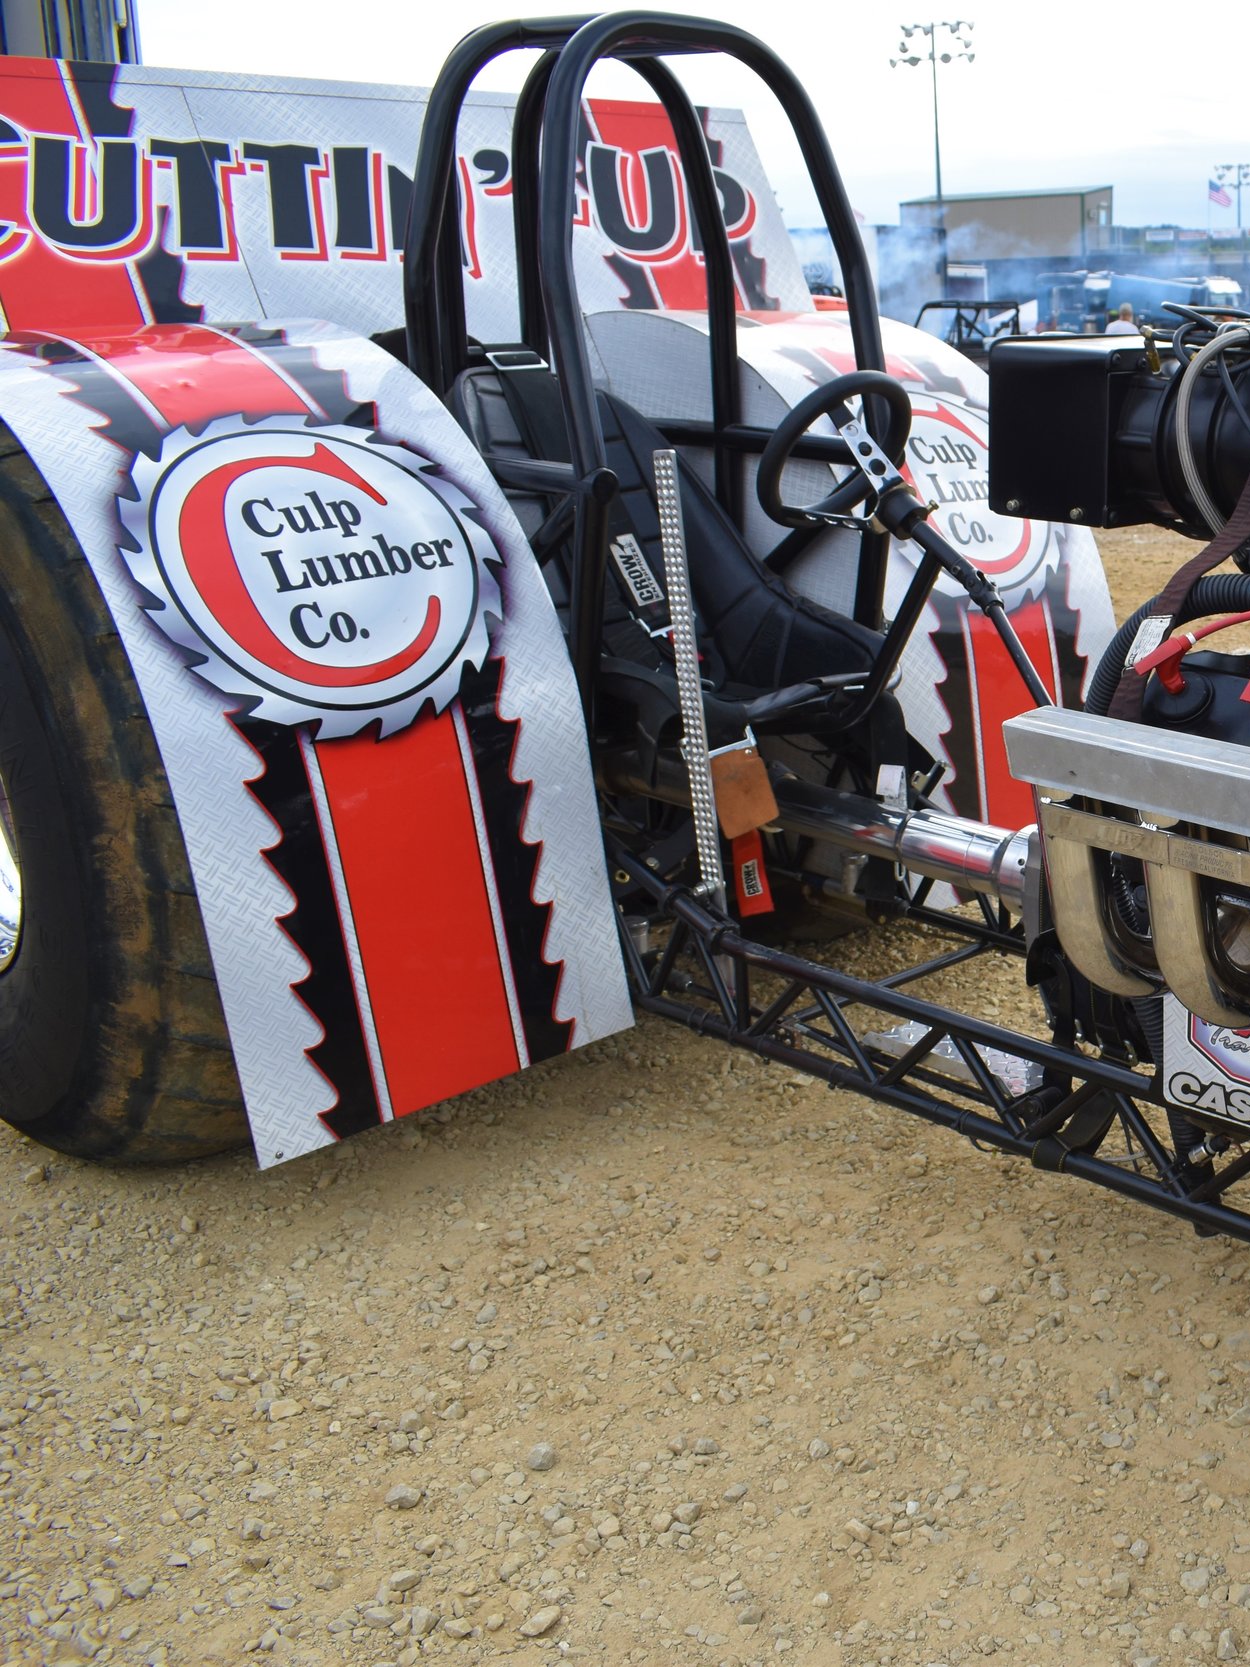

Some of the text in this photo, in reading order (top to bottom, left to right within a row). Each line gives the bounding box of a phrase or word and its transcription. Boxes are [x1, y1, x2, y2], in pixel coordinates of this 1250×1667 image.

[908, 435, 978, 470] Culp
[925, 470, 989, 504] Lum
[240, 490, 362, 539] Culp
[947, 511, 994, 546] Co.
[260, 533, 455, 594] Lumber
[618, 554, 655, 602] CROW
[289, 601, 371, 650] Co.
